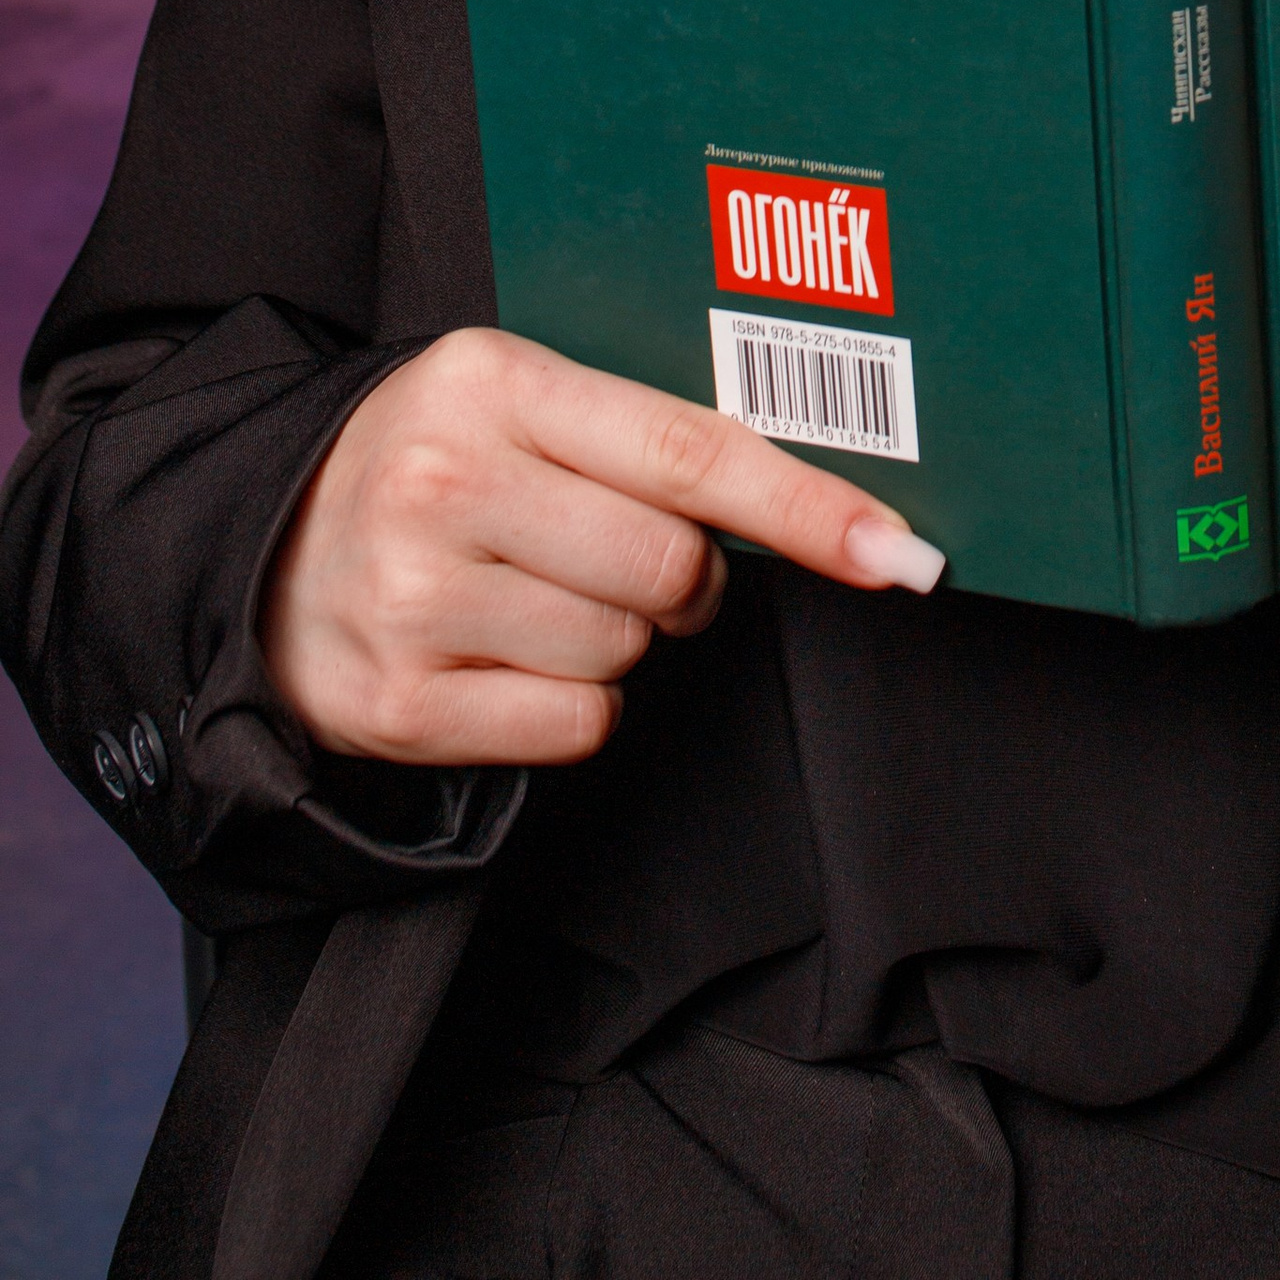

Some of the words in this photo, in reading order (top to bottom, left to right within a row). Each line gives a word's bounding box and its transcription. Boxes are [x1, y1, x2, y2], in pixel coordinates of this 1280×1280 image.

[1170, 10, 1189, 125] Чингисхан
[1195, 4, 1212, 103] Рассказы
[704, 143, 799, 168] Литературное
[801, 158, 885, 181] приложение
[727, 187, 879, 299] ОГОНЁК
[732, 319, 766, 337] ISBN
[771, 325, 896, 358] 978-5-275-01855-4
[1185, 271, 1215, 322] Ян
[1189, 333, 1223, 478] Василий
